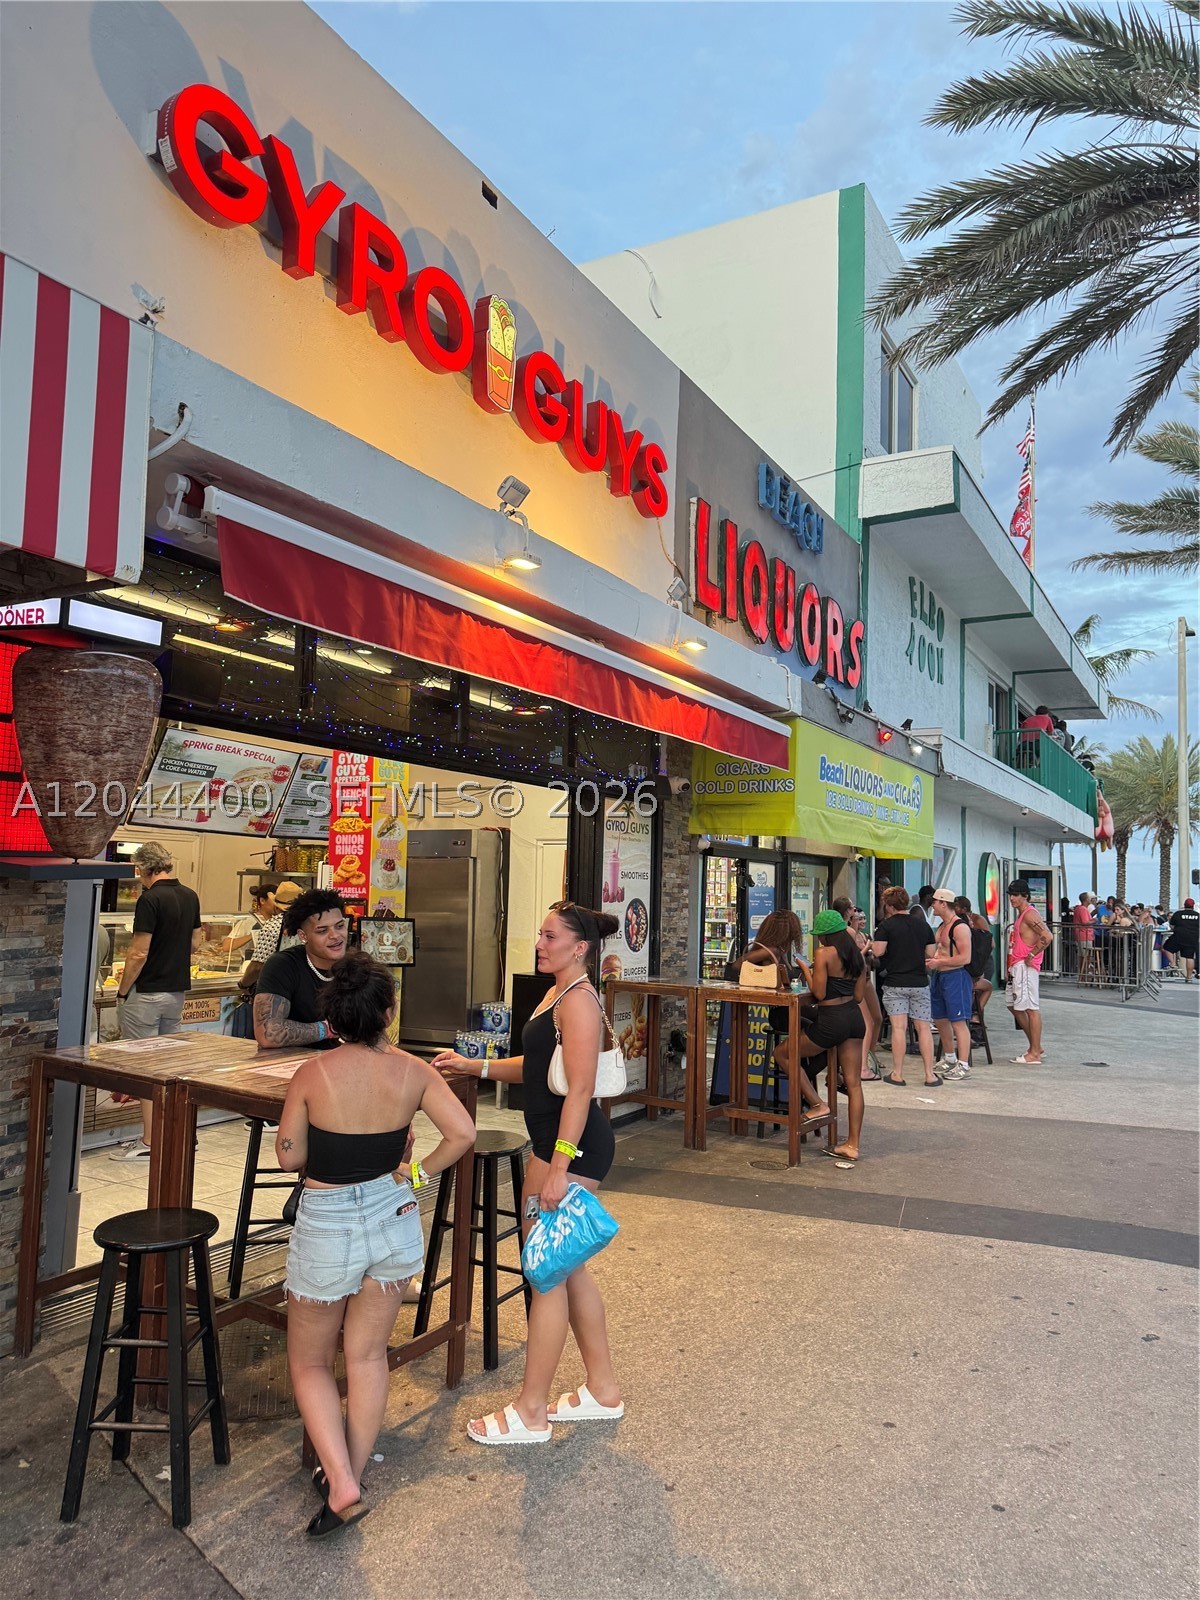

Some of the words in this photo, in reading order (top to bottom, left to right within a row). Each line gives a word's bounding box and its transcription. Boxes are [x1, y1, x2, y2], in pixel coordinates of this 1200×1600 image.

[157, 84, 475, 374] GYRO
[514, 351, 668, 519] GUYS
[758, 463, 824, 555] BEACH
[689, 497, 865, 690] LIQUORS
[908, 575, 945, 643] ELBO
[182, 739, 214, 751] SPRNG
[214, 743, 243, 755] BREAK
[243, 749, 276, 764] SPECIAL
[162, 758, 184, 768] CHICKEN
[715, 761, 771, 777] CIGARS
[165, 764, 181, 772] COKE
[187, 768, 207, 776] WATER
[336, 764, 367, 777] GUYS
[378, 766, 405, 781] GUYS
[334, 775, 371, 784] APPETIZERS
[819, 754, 844, 787] Beach
[844, 763, 884, 799] LIQUORS
[883, 781, 895, 798] AND
[894, 781, 921, 811] CIGARS
[695, 780, 735, 795] COLD
[738, 778, 796, 794] DRINKS
[837, 793, 853, 813] COLD
[605, 819, 626, 832] GYRO
[630, 821, 650, 835] GUYS
[335, 834, 365, 845] ONION
[335, 844, 364, 855] RINGS
[620, 871, 649, 880] SMOOTHIES
[605, 930, 622, 940] OWLS
[623, 966, 647, 977] BURGERS
[195, 1000, 210, 1009] 100%
[182, 1009, 216, 1020] NGREDIENTS
[614, 1011, 632, 1021] TIZERS
